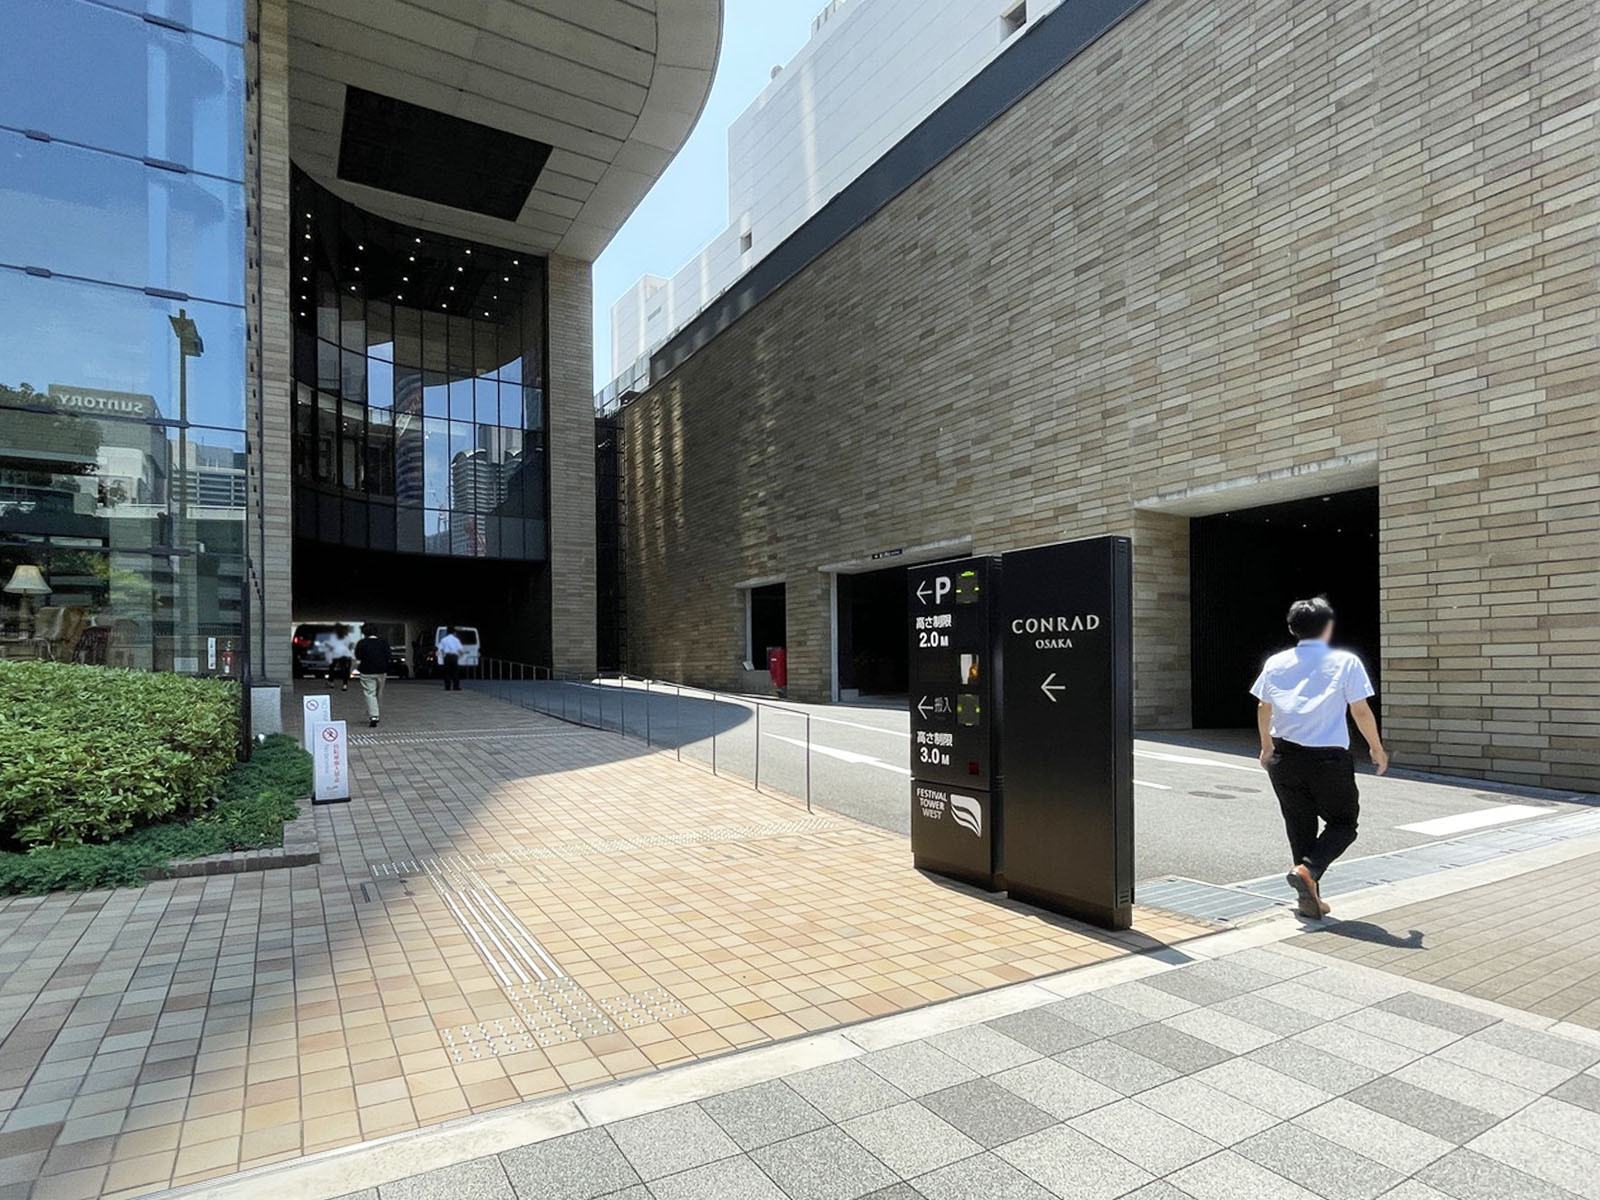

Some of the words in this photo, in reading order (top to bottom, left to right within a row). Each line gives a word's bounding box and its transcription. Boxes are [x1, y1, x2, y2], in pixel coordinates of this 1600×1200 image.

[935, 576, 951, 605] P
[1011, 614, 1100, 634] CONRAD
[1035, 638, 1073, 649] OSAKA
[916, 787, 948, 802] FESTIVAL
[919, 797, 945, 811] TOWER
[921, 807, 943, 820] WEST
